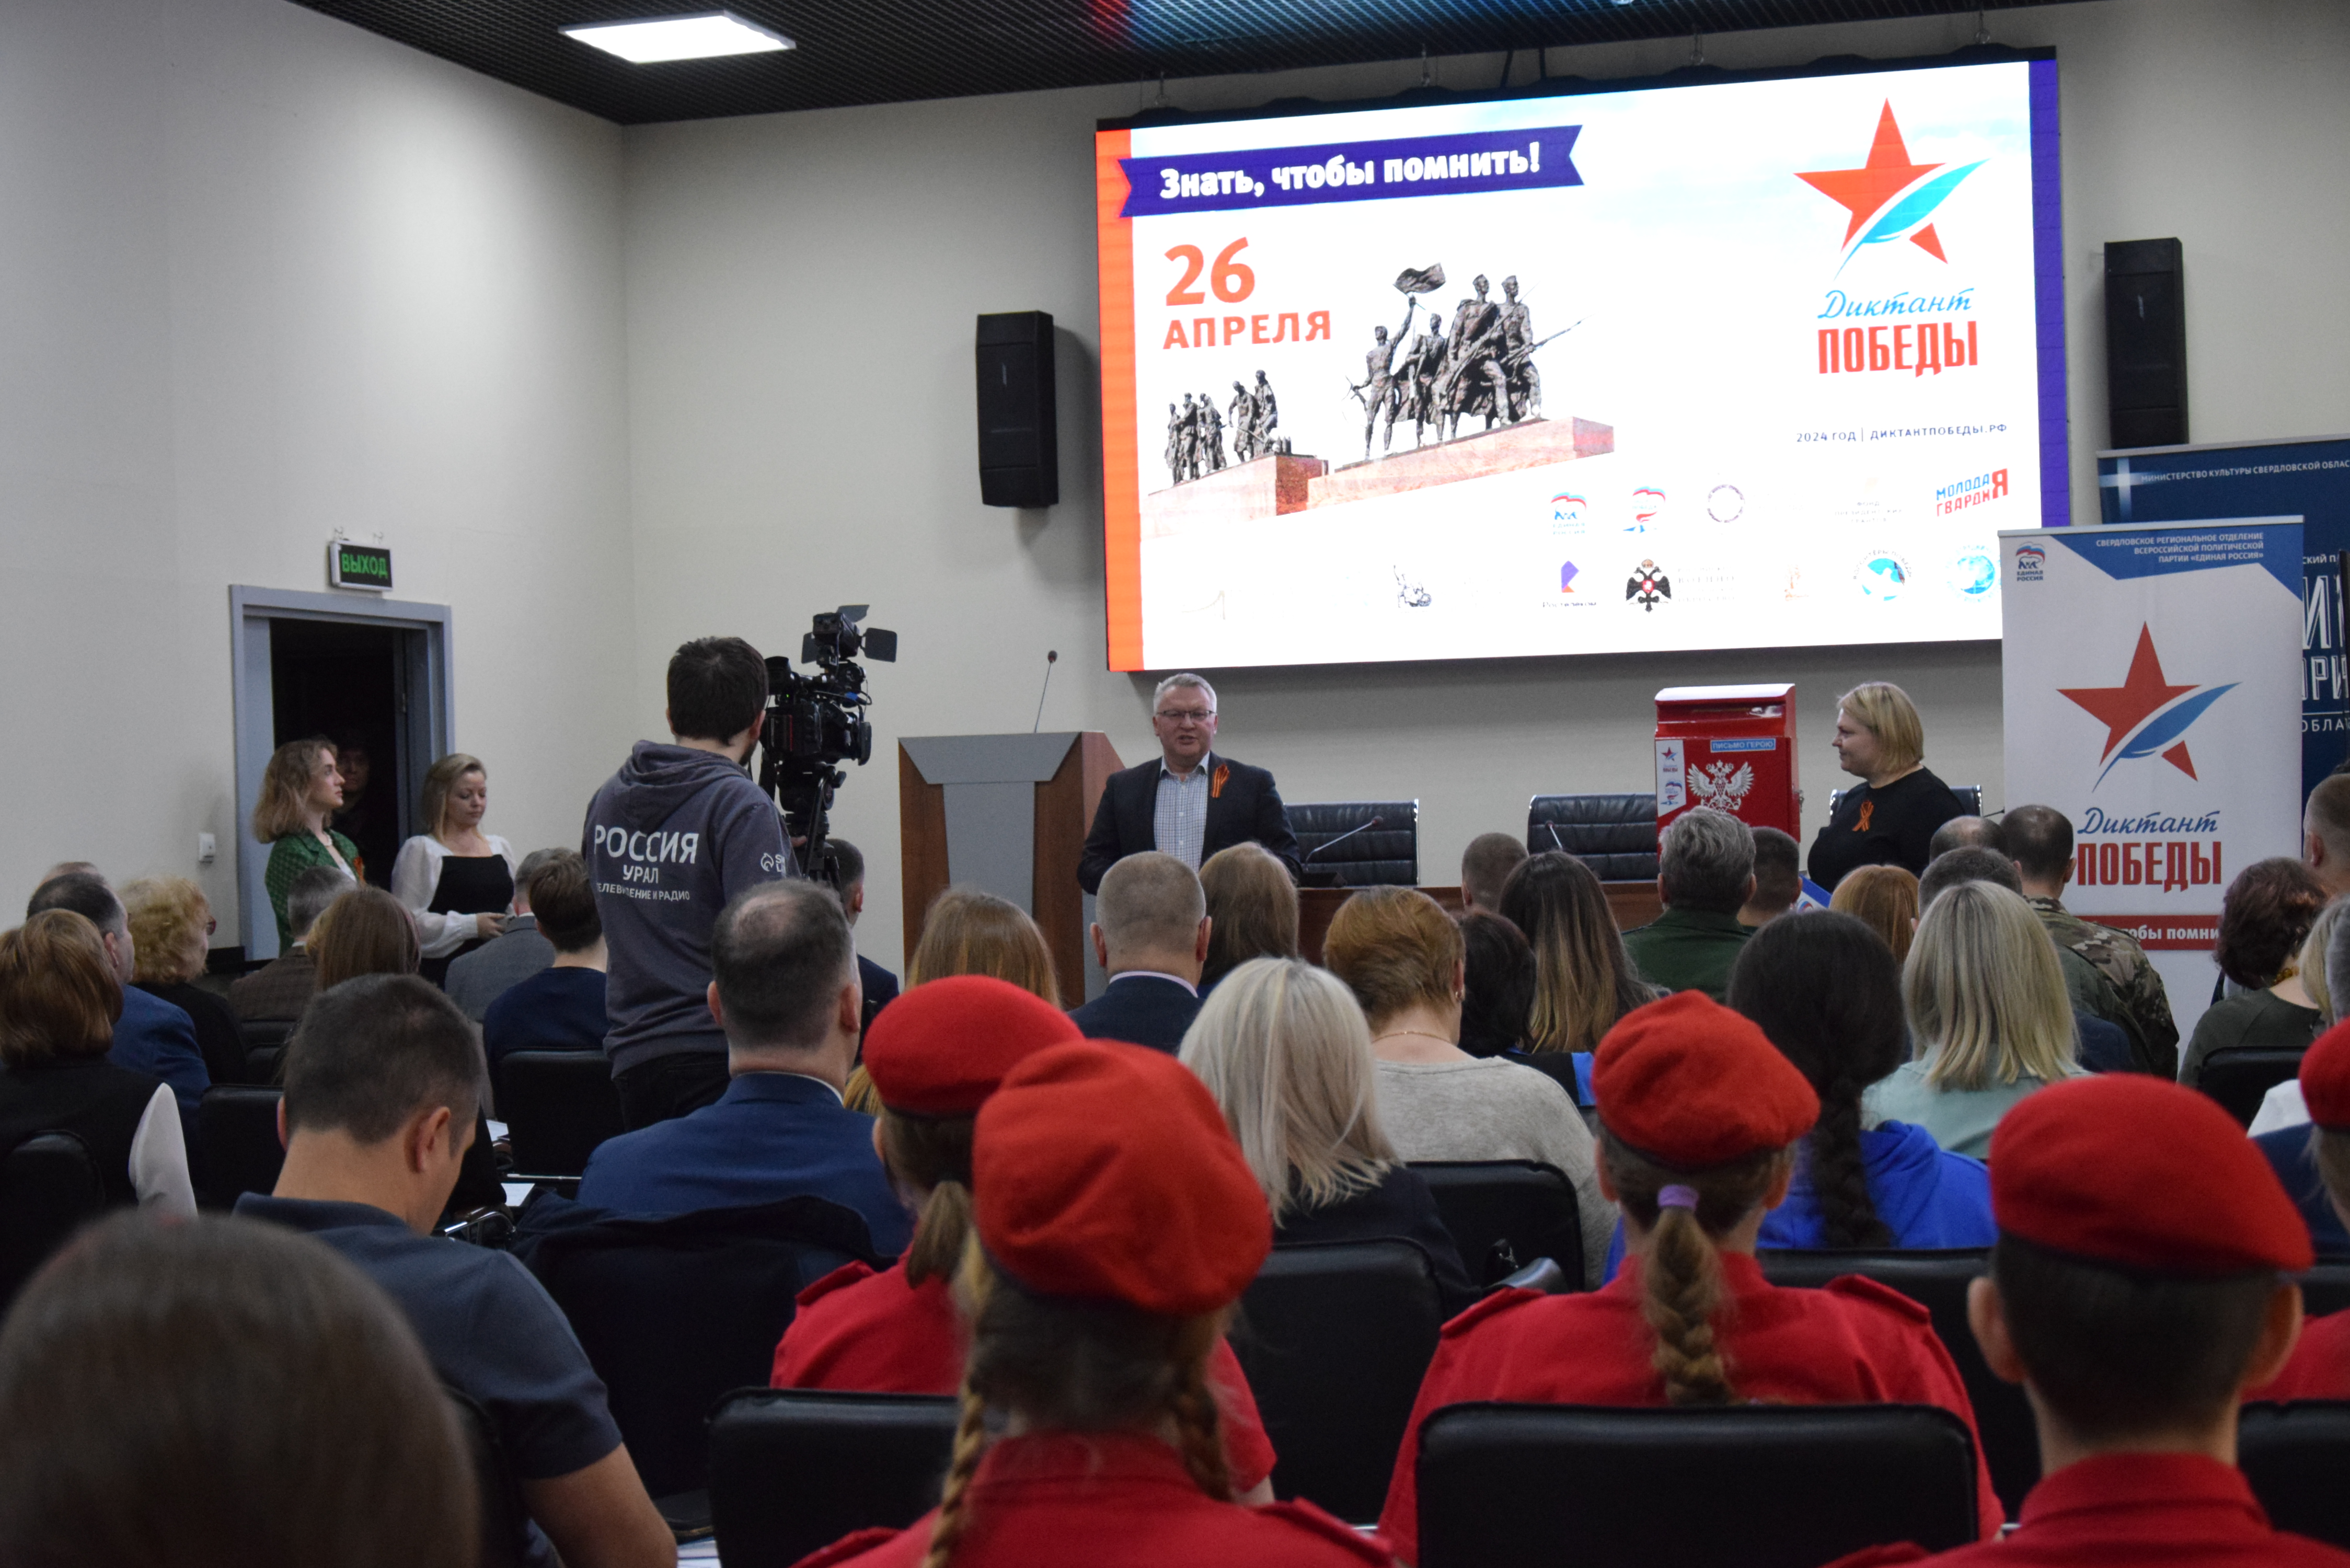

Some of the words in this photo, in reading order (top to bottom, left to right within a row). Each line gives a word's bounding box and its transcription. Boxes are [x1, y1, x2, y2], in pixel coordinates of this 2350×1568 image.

[1160, 167, 1265, 199] Знать,
[1271, 154, 1375, 189] чтобы
[1383, 141, 1540, 184] помнить!
[1164, 236, 1255, 307] 26
[1817, 287, 1975, 319] Диктант
[1162, 309, 1331, 350] АПРЕЛЯ
[1817, 320, 1978, 377] ПОБЕДЫ
[1796, 431, 1828, 443] 2024
[1832, 431, 1857, 442] ГОД
[1870, 423, 2007, 441] ДИКТАНТПОБЕДЫ.РФ
[2141, 471, 2207, 482] МИНИСТЕРСТВО
[2209, 467, 2252, 478] КУЛЬТУРЫ
[2253, 461, 2321, 475] СВЕРДЛОВСКОЙ
[2096, 537, 2155, 547] СВЕРДЛОВСКОЕ
[2157, 535, 2217, 545] РЕГИОНАЛЬНОЕ
[2219, 532, 2264, 542] ОТДЕЛЕНИЕ
[2134, 545, 2199, 555] ВСЕРОССИЙСКОЙ
[2201, 540, 2264, 552] ПОЛИТИЧЕСКОЙ
[341, 552, 388, 579] ВЫХОД
[2159, 555, 2189, 563] ПАРТИИ
[2191, 553, 2226, 562] «ЕДИНАЯ
[2228, 552, 2264, 560] РОССИЯ»
[2077, 807, 2220, 834] Диктант
[594, 825, 699, 864] РОССИЯ
[623, 864, 659, 883] УРАЛ
[2077, 841, 2221, 893] ПОБЕДЫ
[659, 890, 690, 902] РАДИО
